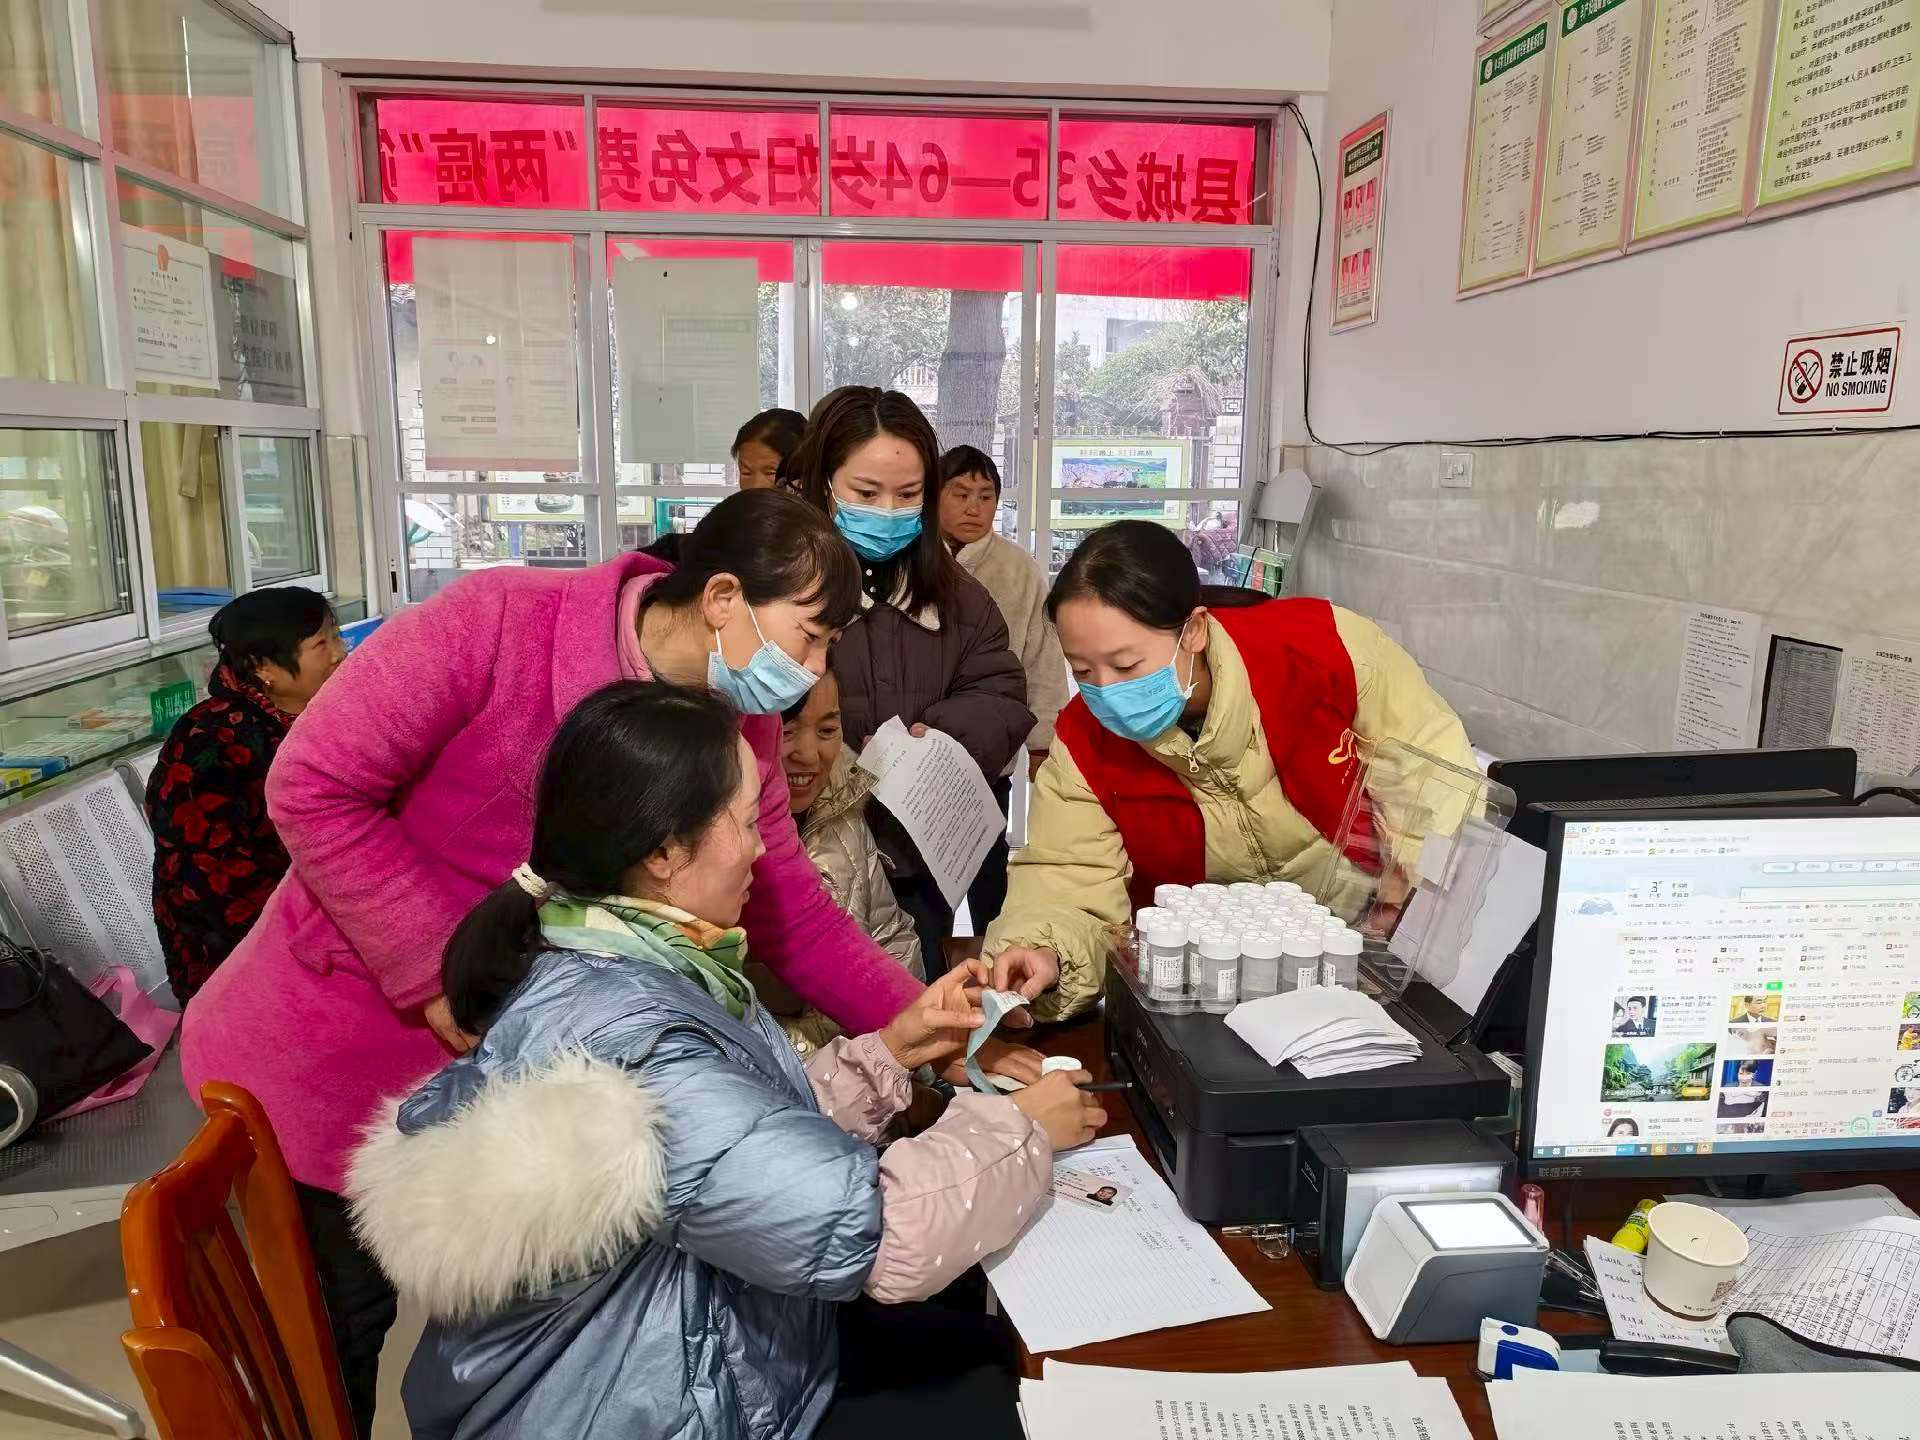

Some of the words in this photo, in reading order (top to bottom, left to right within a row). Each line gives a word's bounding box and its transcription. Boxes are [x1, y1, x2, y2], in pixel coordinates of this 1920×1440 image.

[1829, 347, 1892, 379] 禁止吸烟
[1826, 382, 1840, 397] NO
[1842, 379, 1887, 396] SMOKING
